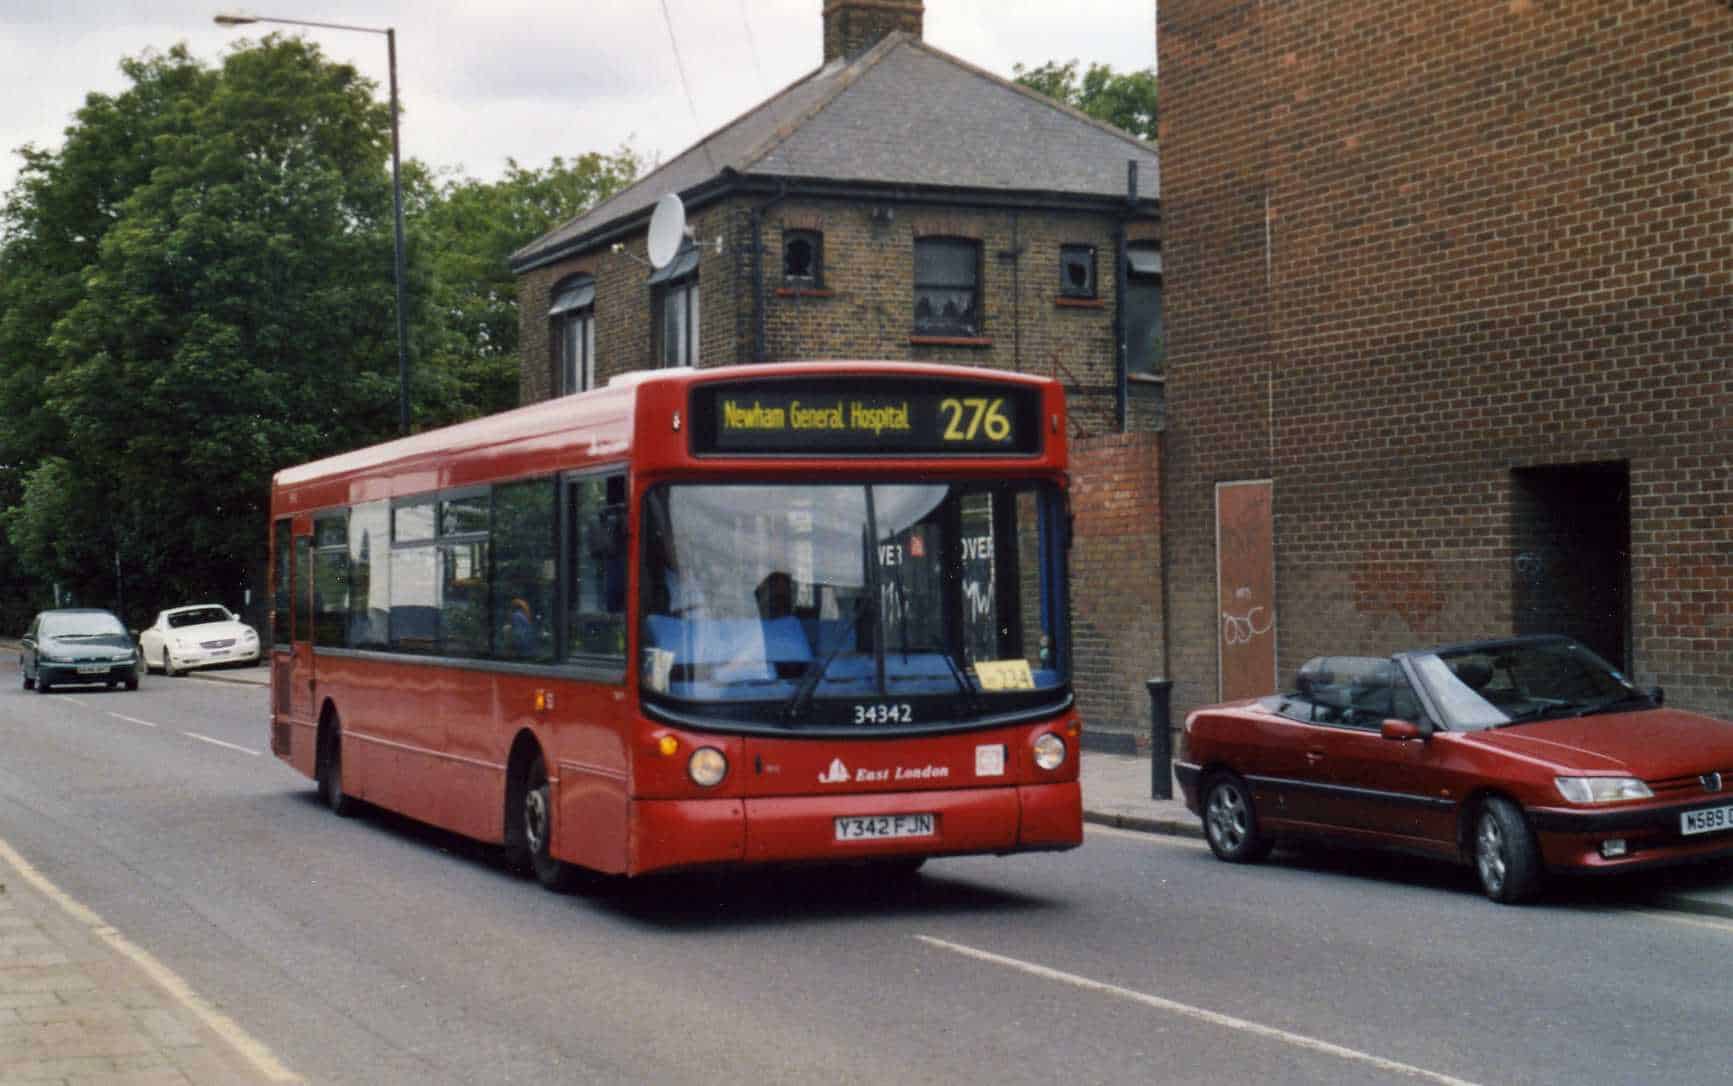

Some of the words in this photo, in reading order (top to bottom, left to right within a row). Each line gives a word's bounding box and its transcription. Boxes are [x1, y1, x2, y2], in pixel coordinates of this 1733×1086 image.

[724, 401, 784, 429] Newham
[789, 400, 845, 429] General
[850, 401, 911, 435] Hospital
[940, 398, 1010, 440] 276
[854, 704, 912, 724] 34342
[856, 768, 889, 782] East
[895, 764, 949, 780] London
[840, 818, 889, 837] Y342
[894, 815, 931, 833] FJN
